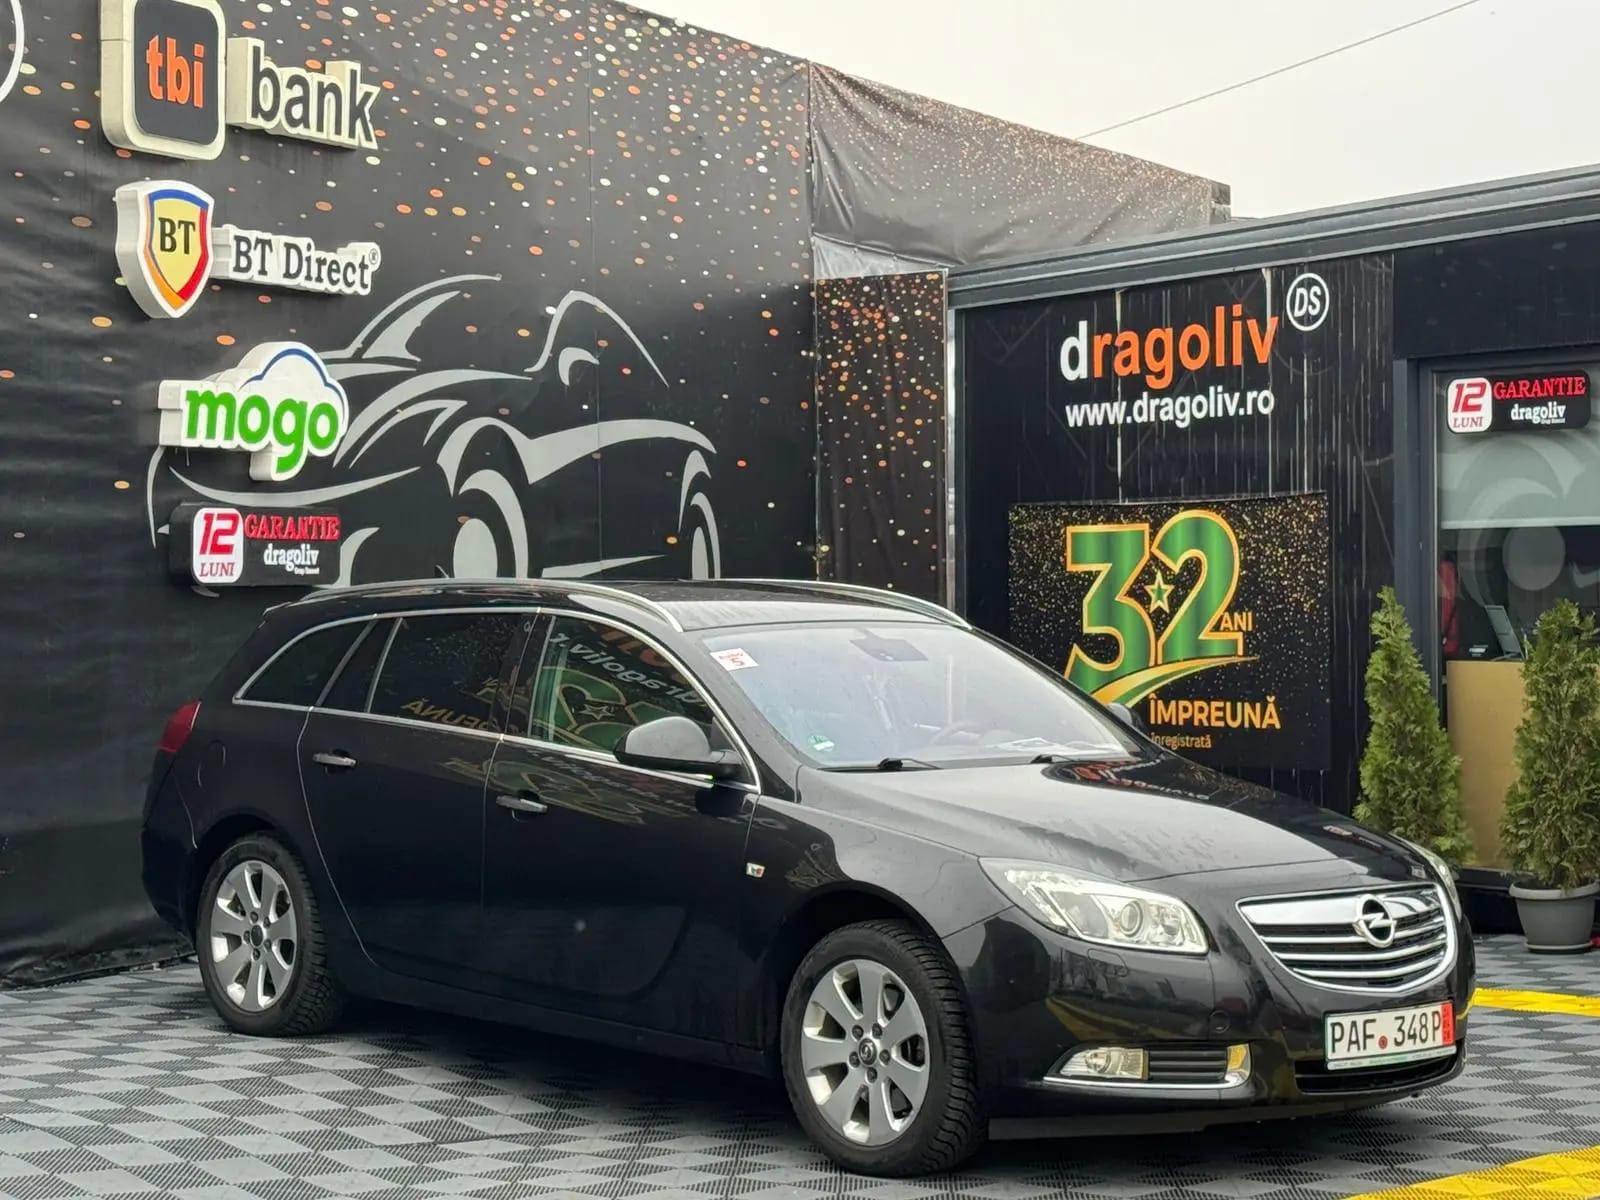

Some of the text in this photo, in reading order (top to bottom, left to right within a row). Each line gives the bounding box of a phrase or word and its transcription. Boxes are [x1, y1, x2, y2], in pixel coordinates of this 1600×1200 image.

[146, 35, 377, 143] tbi bank
[158, 217, 196, 254] BT
[233, 235, 273, 276] BT
[1294, 286, 1321, 317] DS
[1060, 303, 1279, 389] dragoliv
[1452, 382, 1487, 413] 12
[1493, 377, 1586, 399] GARANTIE
[1065, 384, 1275, 429] www.dragoliv.ro
[1453, 416, 1484, 428] LUNI
[1510, 400, 1566, 424] dragoliv
[186, 389, 339, 473] mogo
[200, 513, 239, 555] 12
[244, 513, 341, 541] GARANTIE
[200, 562, 235, 577] LUNI
[263, 543, 319, 572] dragoliv
[1064, 509, 1243, 696] 32
[1220, 611, 1253, 632] ANI
[1149, 693, 1281, 729] ÎMPREUNĂ
[1330, 1018, 1377, 1053] PAF
[1393, 1010, 1441, 1047] 348P
